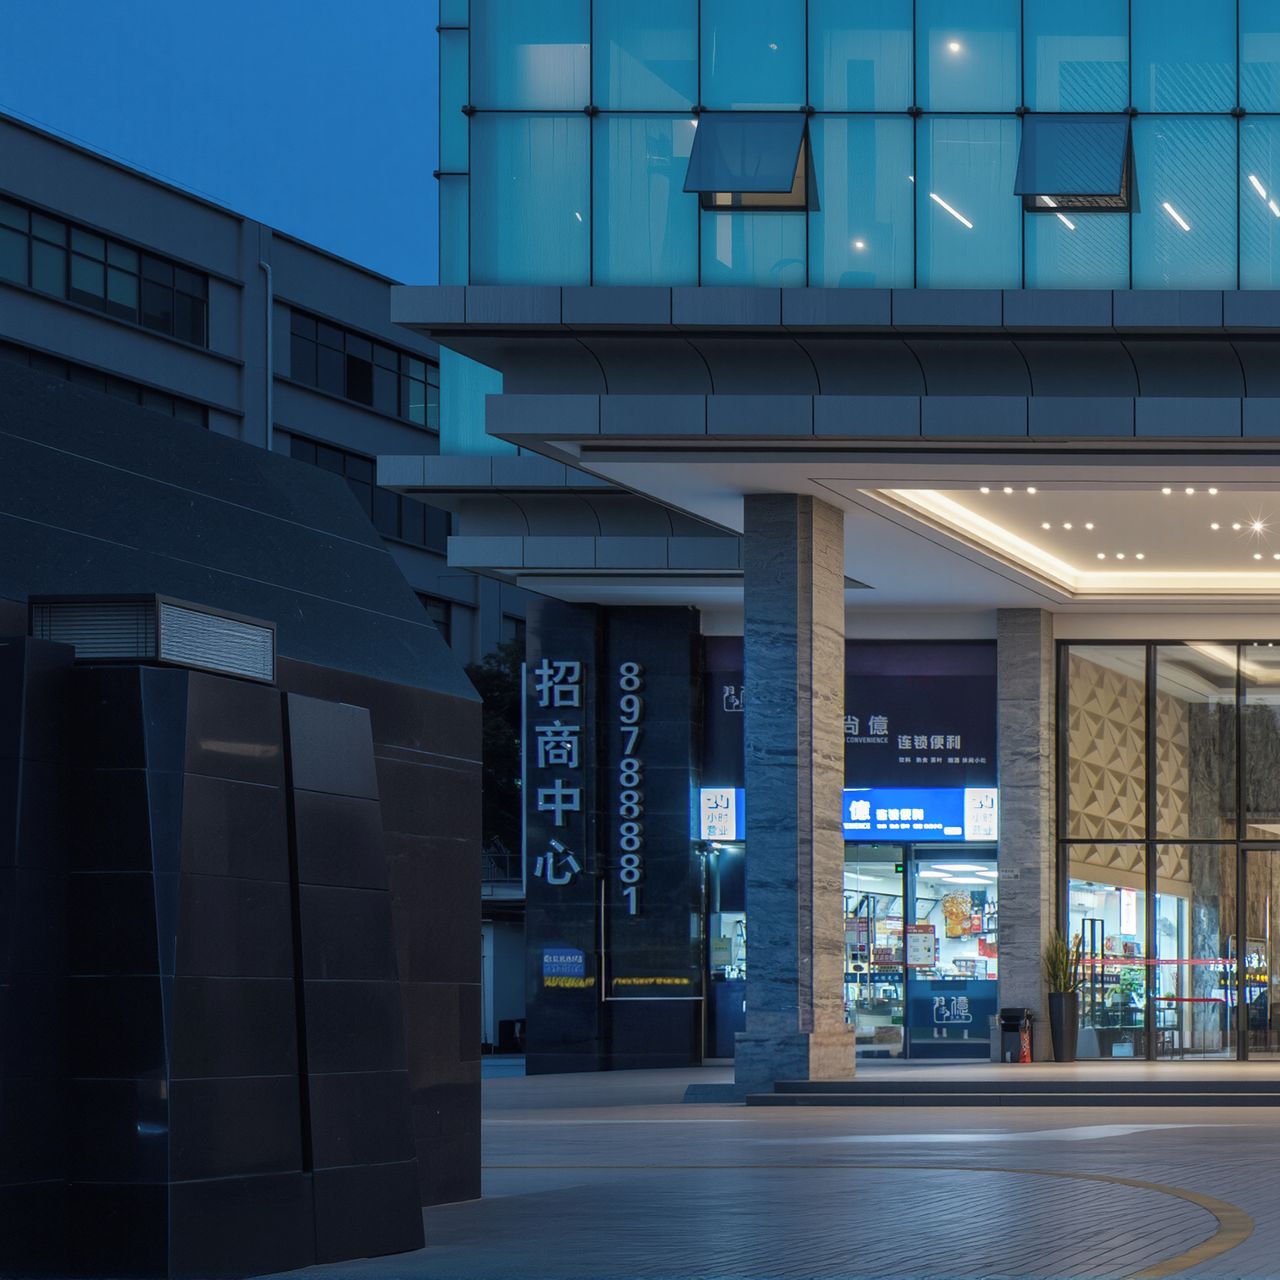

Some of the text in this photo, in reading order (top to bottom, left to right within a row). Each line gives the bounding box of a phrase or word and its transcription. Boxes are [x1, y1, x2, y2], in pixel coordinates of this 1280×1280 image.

[534, 658, 582, 886] 招商中心
[619, 661, 644, 915] 89788881
[846, 736, 889, 744] CONVENIENCE
[897, 735, 961, 750] 连锁便利
